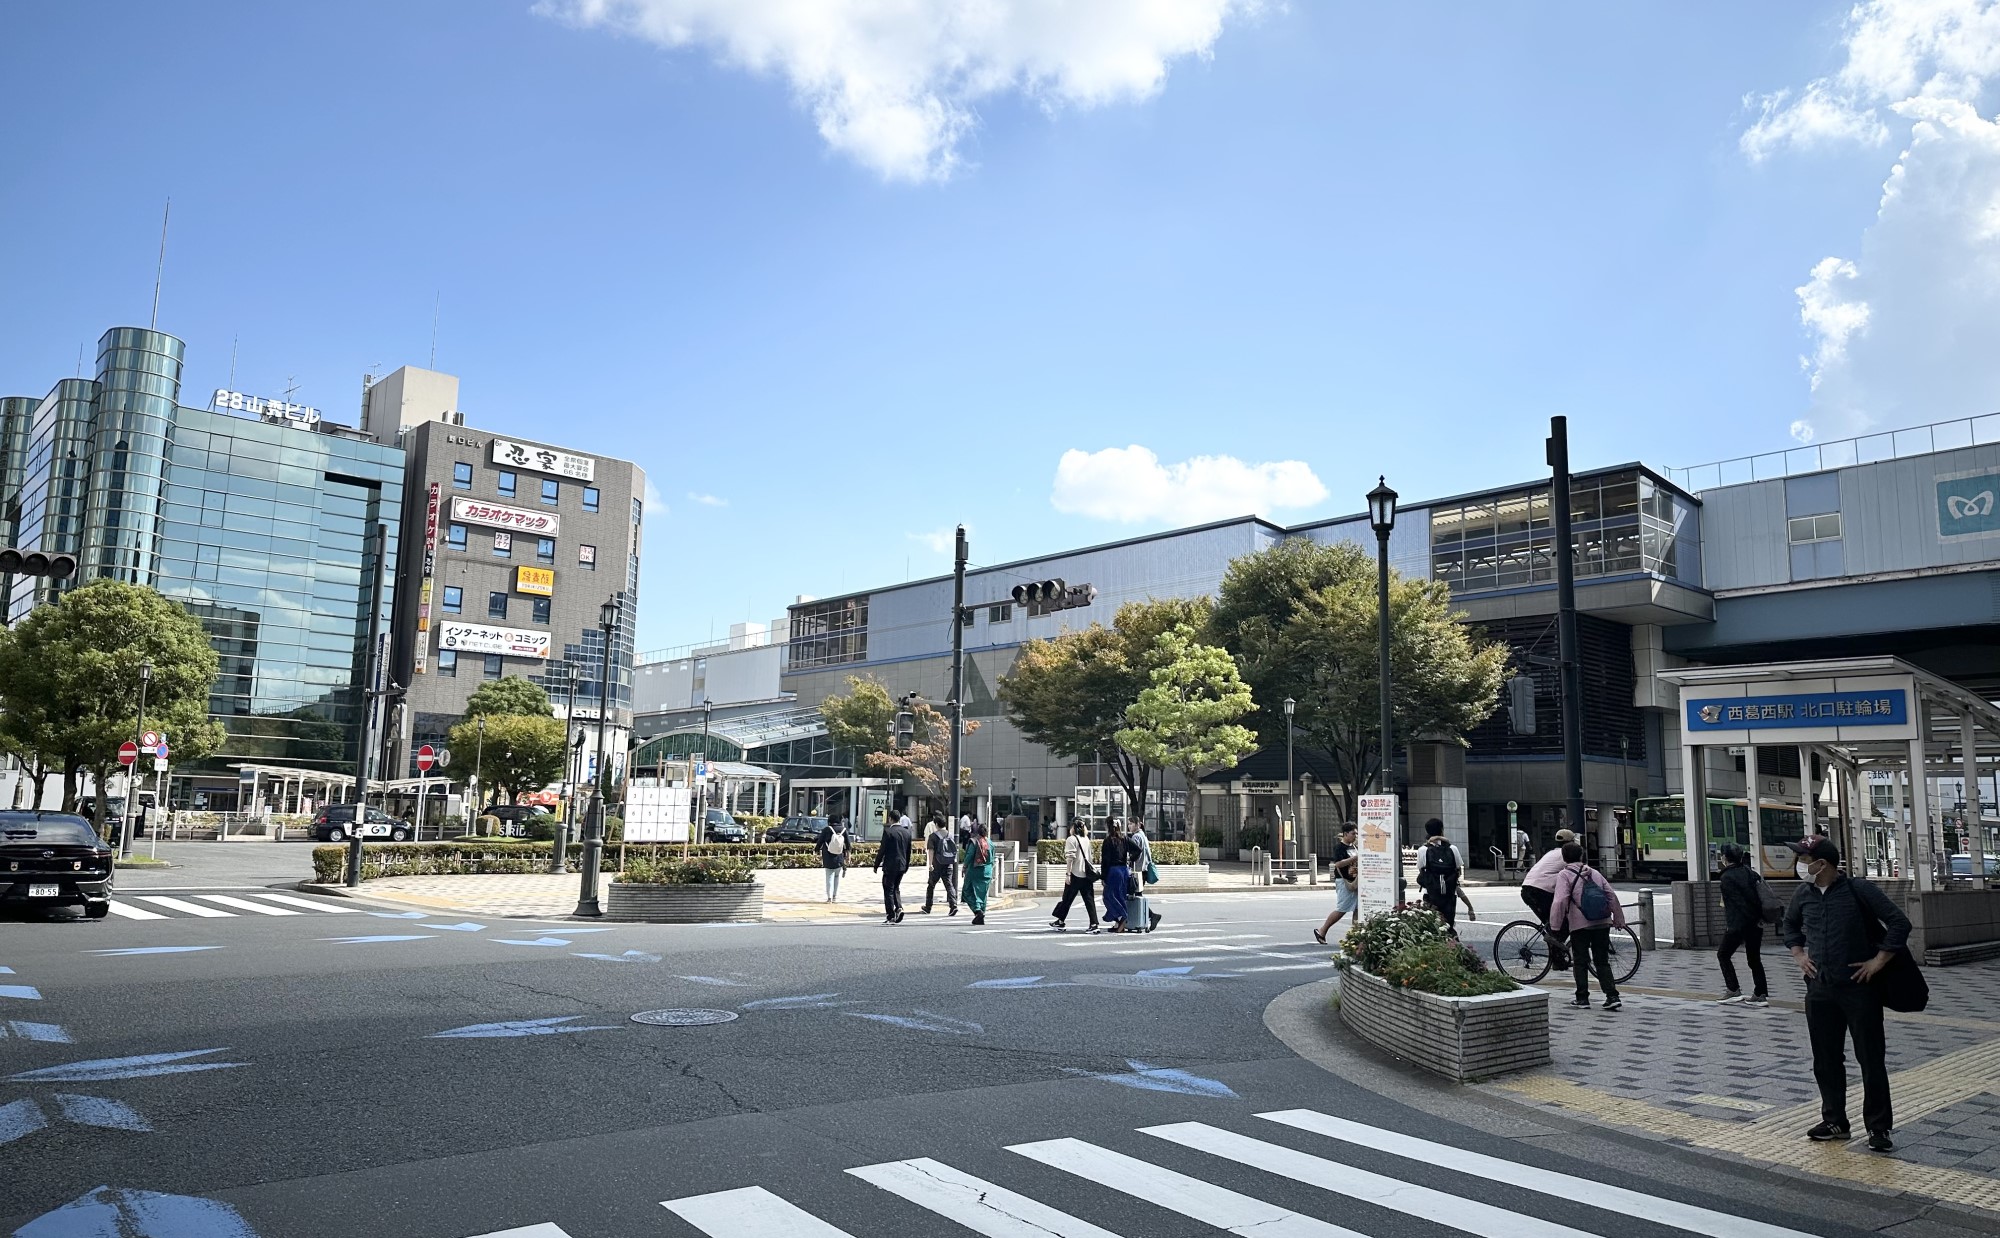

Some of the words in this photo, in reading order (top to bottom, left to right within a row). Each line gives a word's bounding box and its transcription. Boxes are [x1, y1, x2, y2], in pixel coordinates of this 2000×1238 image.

[505, 443, 558, 471] 忍家
[428, 485, 439, 533] カラオケ
[465, 504, 549, 529] カラオケマック
[445, 627, 503, 641] インターネット
[515, 634, 547, 645] コミック
[550, 703, 613, 721] WESTEN
[1727, 703, 1795, 721] 西葛西駅
[1800, 699, 1892, 718] 北口駐輪場
[698, 764, 705, 774] P
[371, 825, 387, 834] GO
